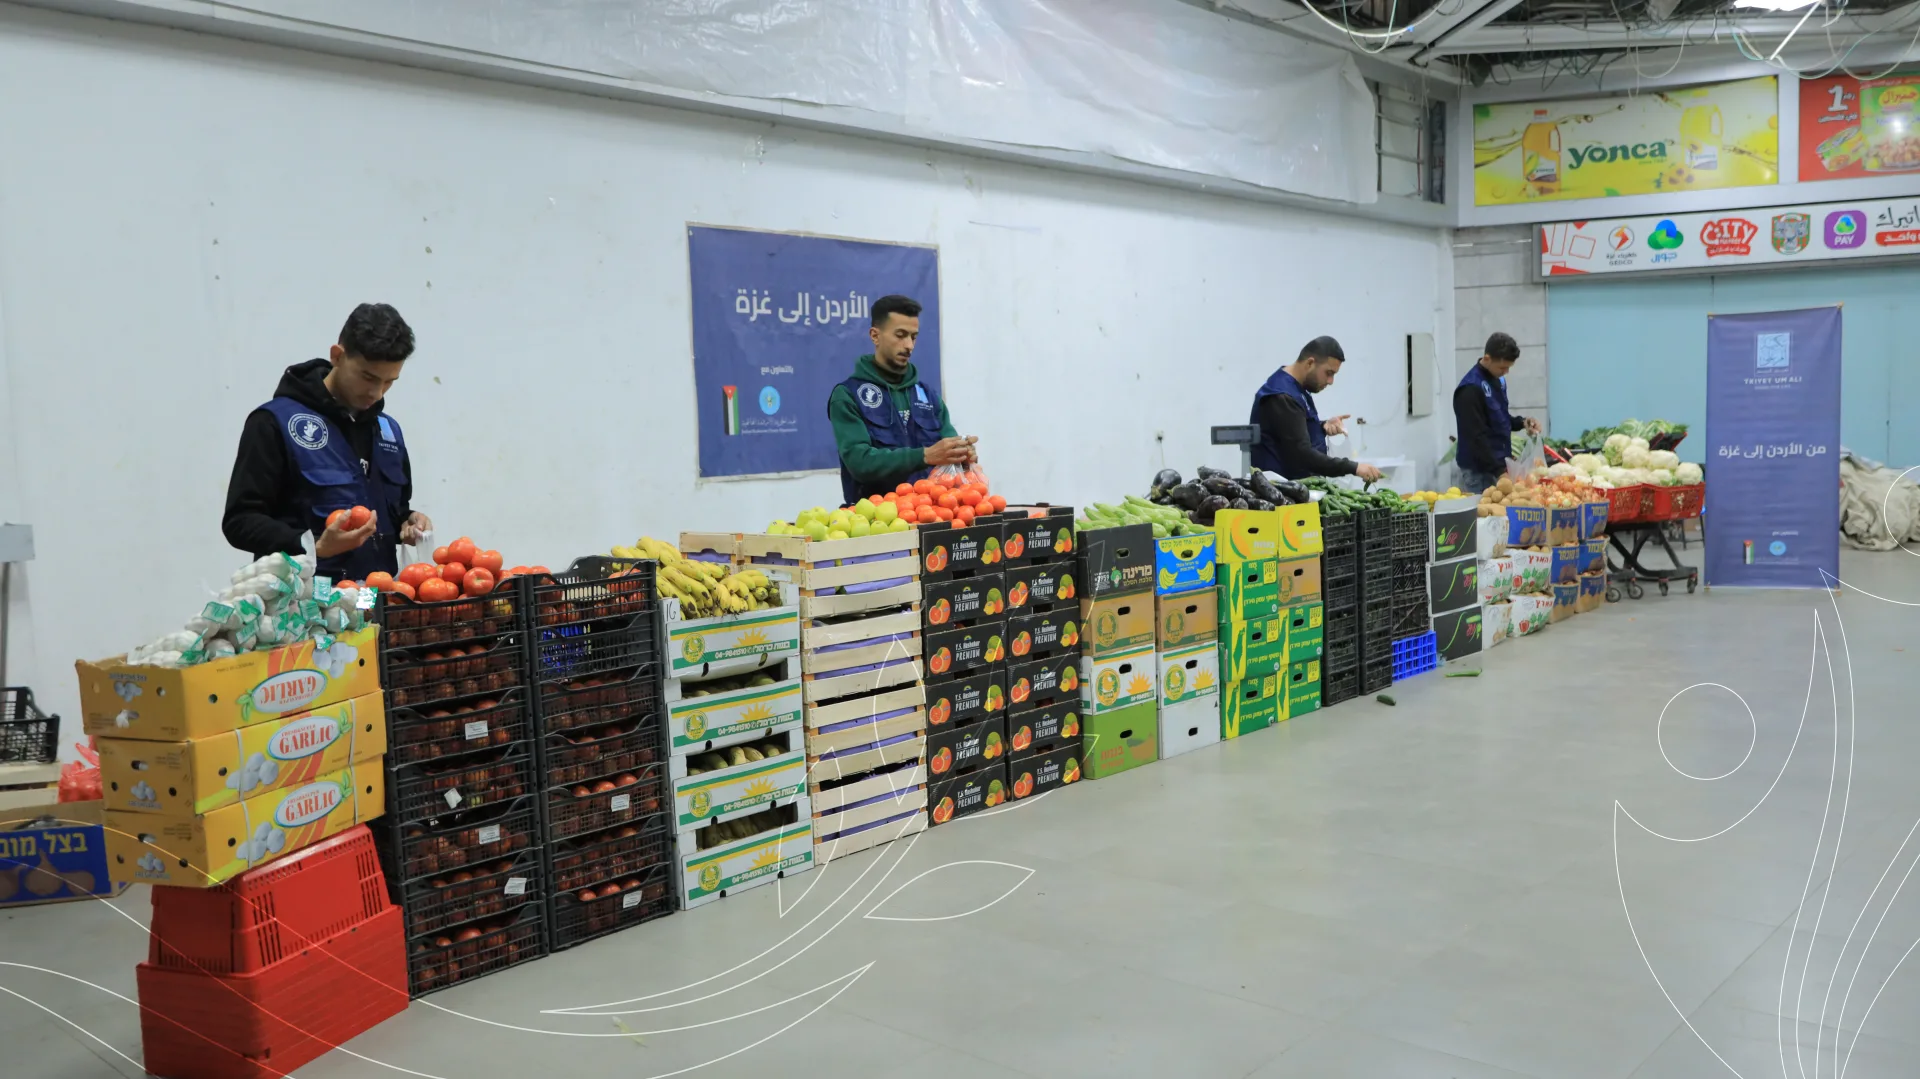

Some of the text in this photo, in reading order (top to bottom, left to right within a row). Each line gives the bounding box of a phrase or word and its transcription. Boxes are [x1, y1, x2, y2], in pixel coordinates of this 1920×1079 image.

[1828, 85, 1848, 112] 1
[1568, 140, 1667, 169] yonca
[1702, 220, 1756, 245] CITY
[1834, 235, 1854, 245] PAY
[735, 288, 869, 326] الأردن إلى غزة
[1719, 444, 1826, 458] من الأردن إلى غزة
[1516, 510, 1540, 521] מובחר
[1028, 538, 1051, 549] PREMIUM
[952, 550, 977, 561] PREMIUM
[1529, 555, 1549, 564] הארץ
[1123, 565, 1152, 579] מרינה
[1032, 585, 1053, 596] PREMIUM
[955, 601, 979, 612] PREMIUM
[1035, 633, 1057, 645] PREMIUM
[956, 649, 980, 661] PREMIUM
[261, 675, 317, 704] GARLIC
[1034, 679, 1056, 692] PREMIUM
[955, 700, 980, 712] PREMIUM
[279, 724, 335, 754] GARLIC
[1036, 726, 1057, 739] PREMIUM
[956, 747, 979, 760] PREMIUM
[1037, 772, 1059, 785] PREMIUM
[285, 789, 336, 821] GARLIC
[957, 795, 981, 808] PREMIUM
[43, 832, 88, 854] בצל
